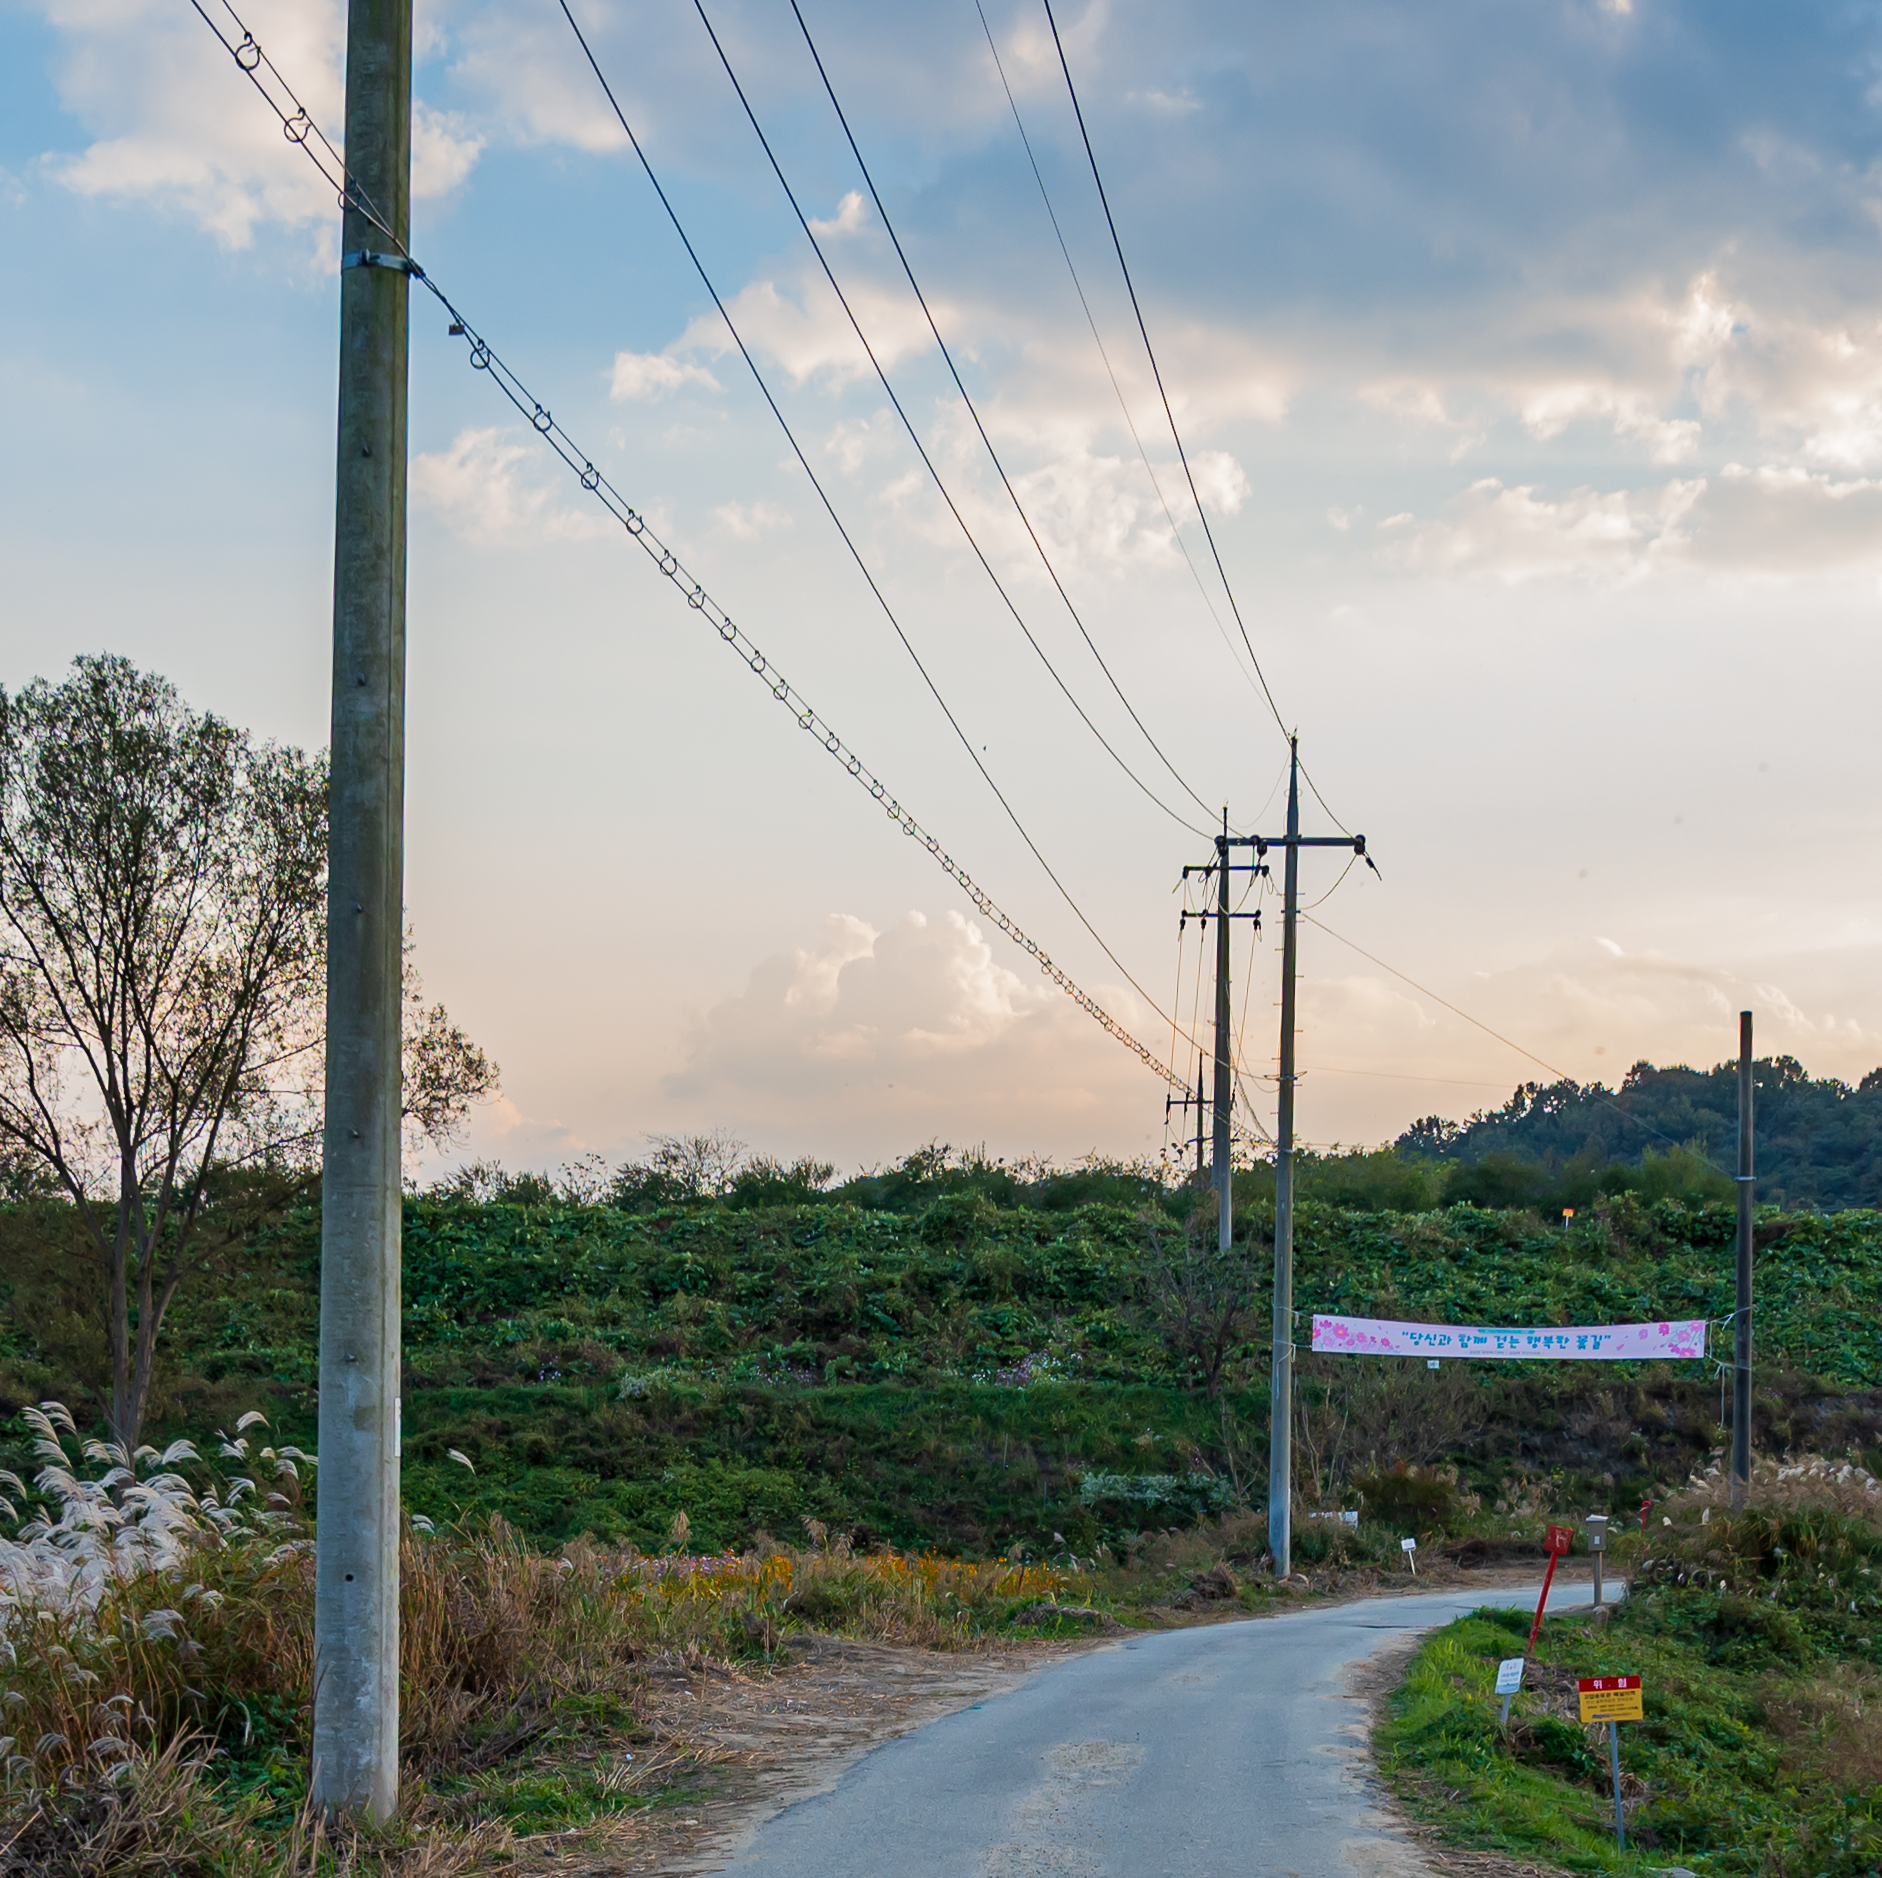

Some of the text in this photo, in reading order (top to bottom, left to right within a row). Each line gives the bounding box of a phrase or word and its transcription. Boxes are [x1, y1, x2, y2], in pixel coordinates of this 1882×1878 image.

[1458, 1333, 1488, 1349] 함께
[1494, 1335, 1520, 1349] 걷는
[1526, 1335, 1570, 1350] 행복한
